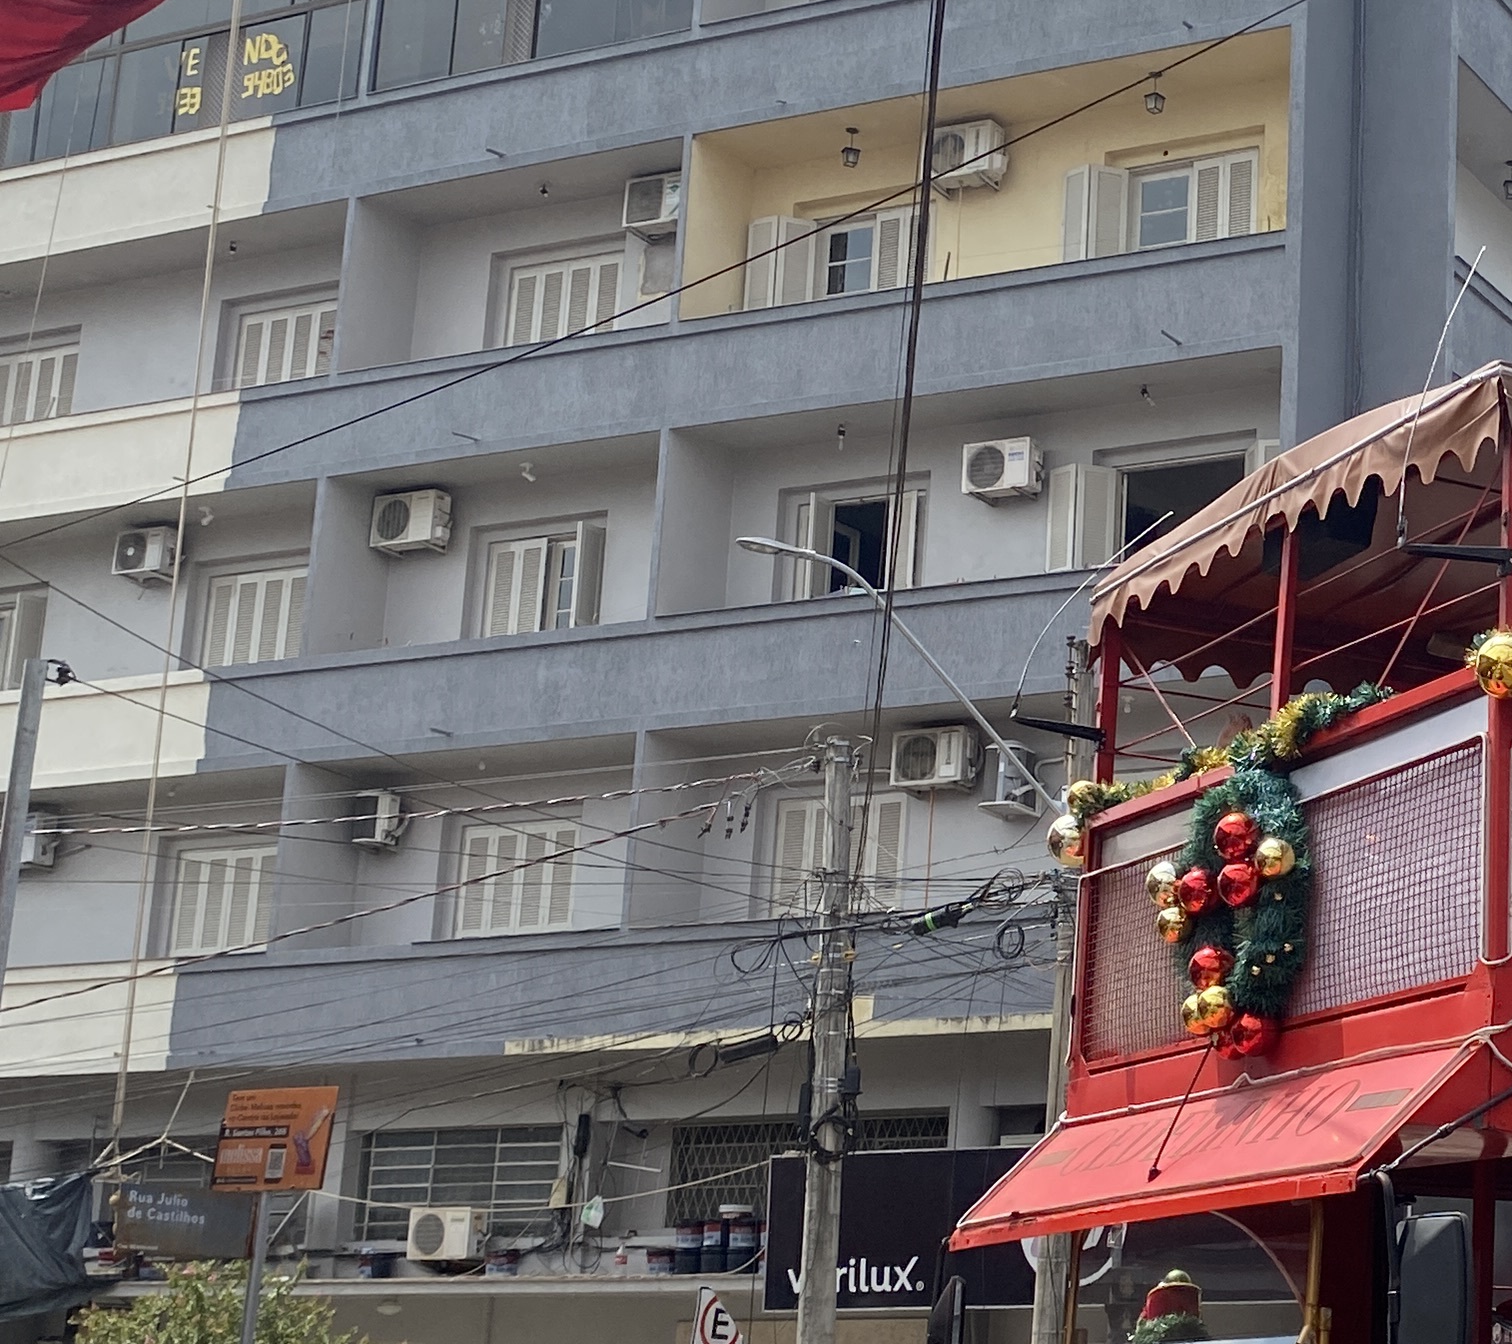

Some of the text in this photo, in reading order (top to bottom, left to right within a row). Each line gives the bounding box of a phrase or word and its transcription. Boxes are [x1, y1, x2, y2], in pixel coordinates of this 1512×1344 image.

[128, 1190, 154, 1204] Rua
[127, 1206, 205, 1225] de Castilhos
[787, 1256, 919, 1294] vrilux
[711, 1308, 729, 1340] E
